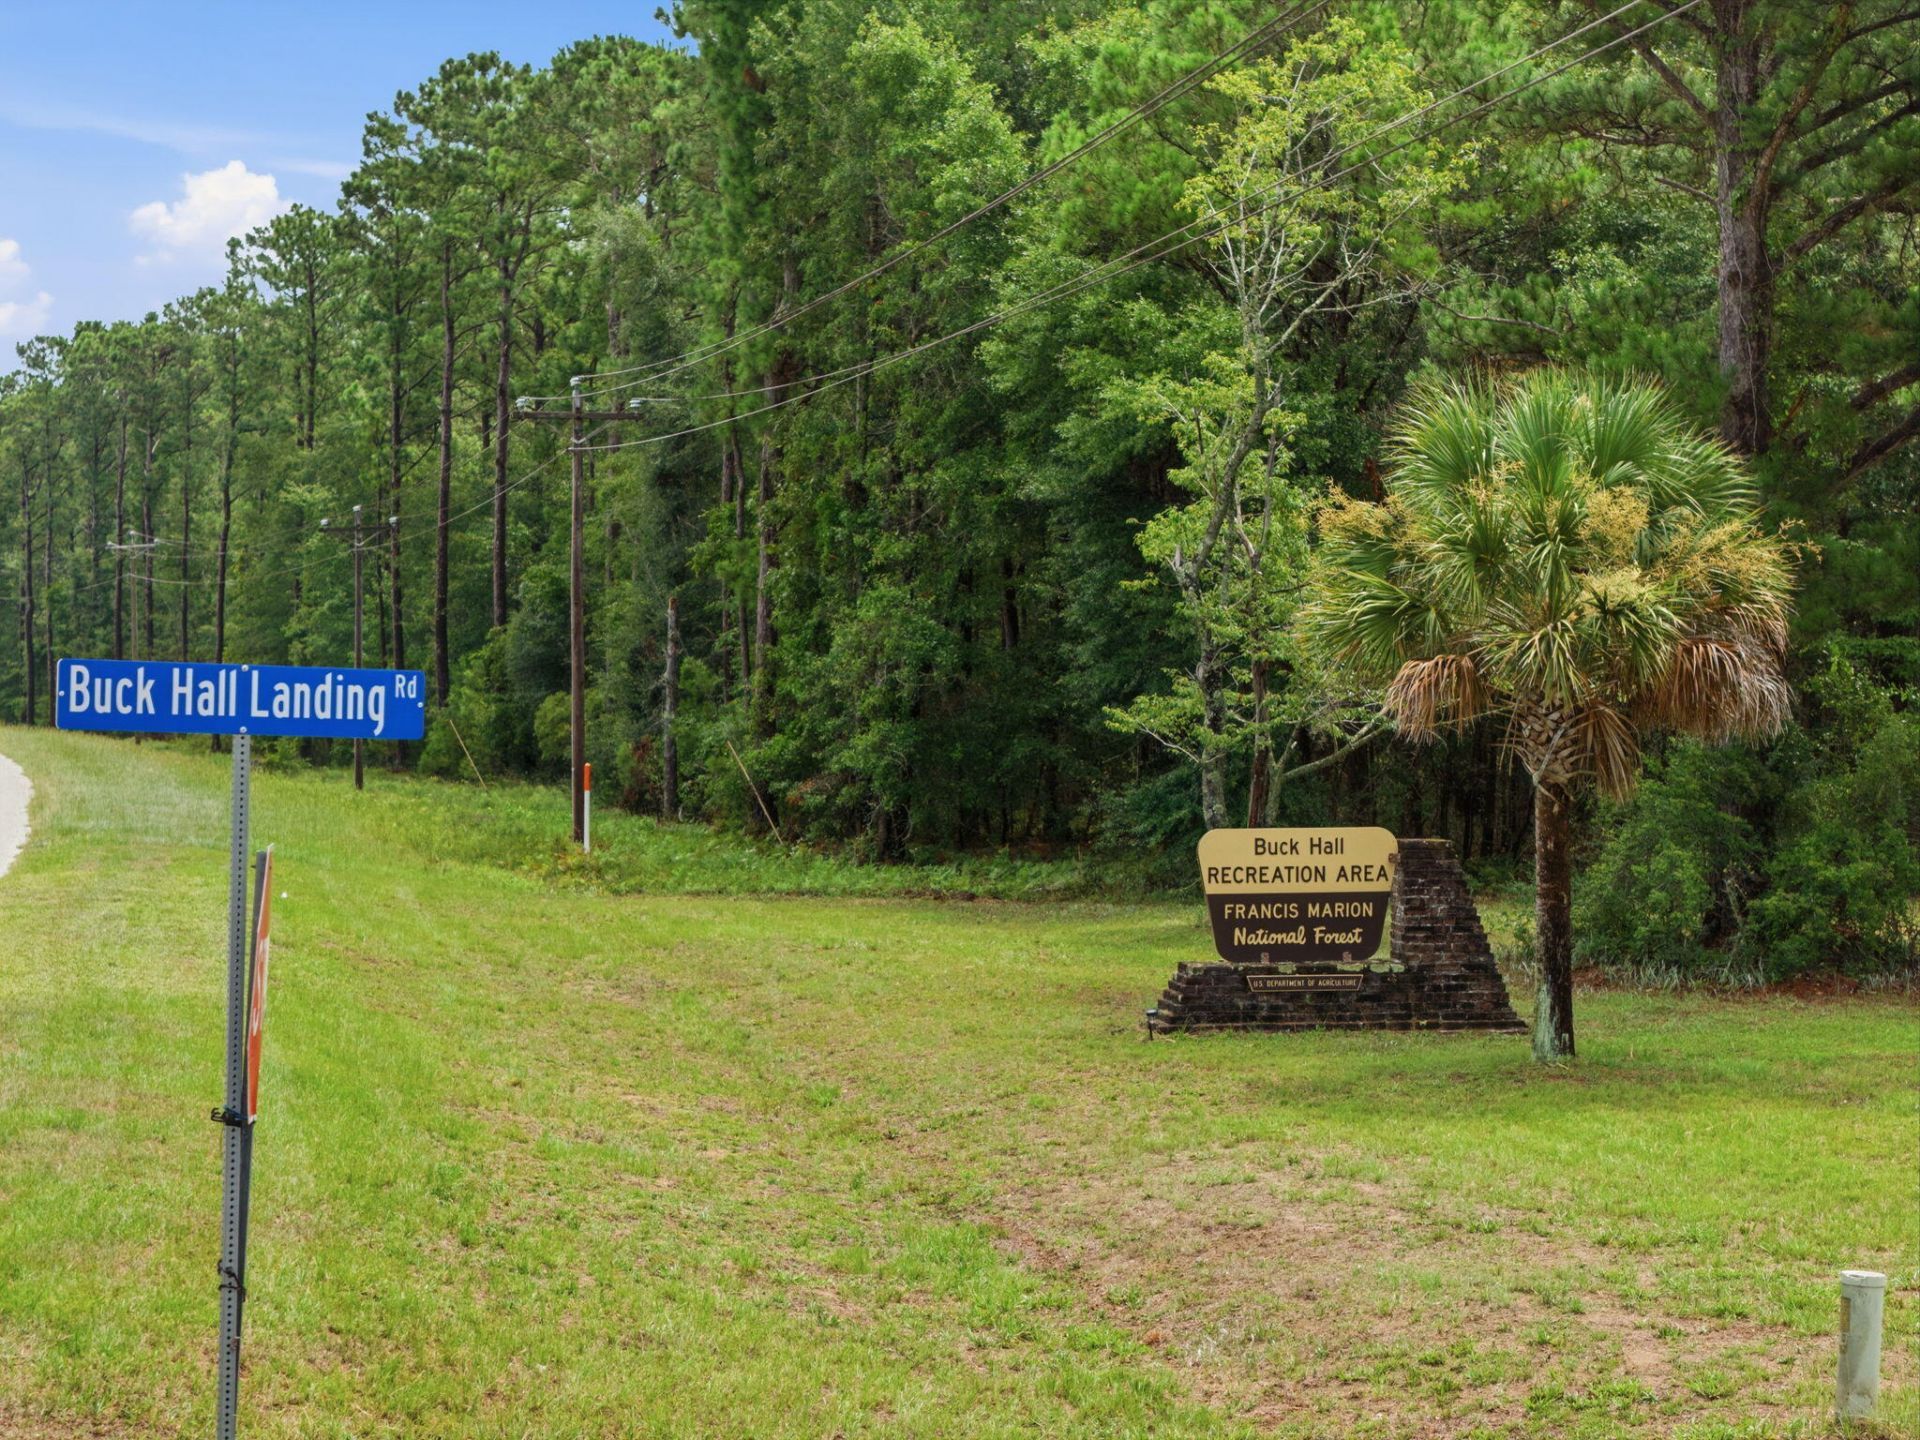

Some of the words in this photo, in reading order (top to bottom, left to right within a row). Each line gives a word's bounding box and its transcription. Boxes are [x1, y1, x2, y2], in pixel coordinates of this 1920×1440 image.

[68, 664, 156, 714] Buck
[171, 667, 237, 717] Hall
[251, 669, 386, 737] Landing
[395, 674, 417, 699] Rd
[1254, 837, 1299, 855] Buck
[1310, 837, 1344, 855] Hall
[1208, 865, 1326, 884] RECREATION
[1336, 864, 1389, 882] AREA
[1224, 903, 1299, 919] FRANCIS
[1307, 902, 1373, 918] MARION
[1233, 925, 1306, 946] National
[1313, 926, 1363, 945] Forest
[1266, 979, 1305, 987] DEPARTMENT
[1307, 979, 1315, 987] OF
[1318, 979, 1356, 987] AGRICULTURE
